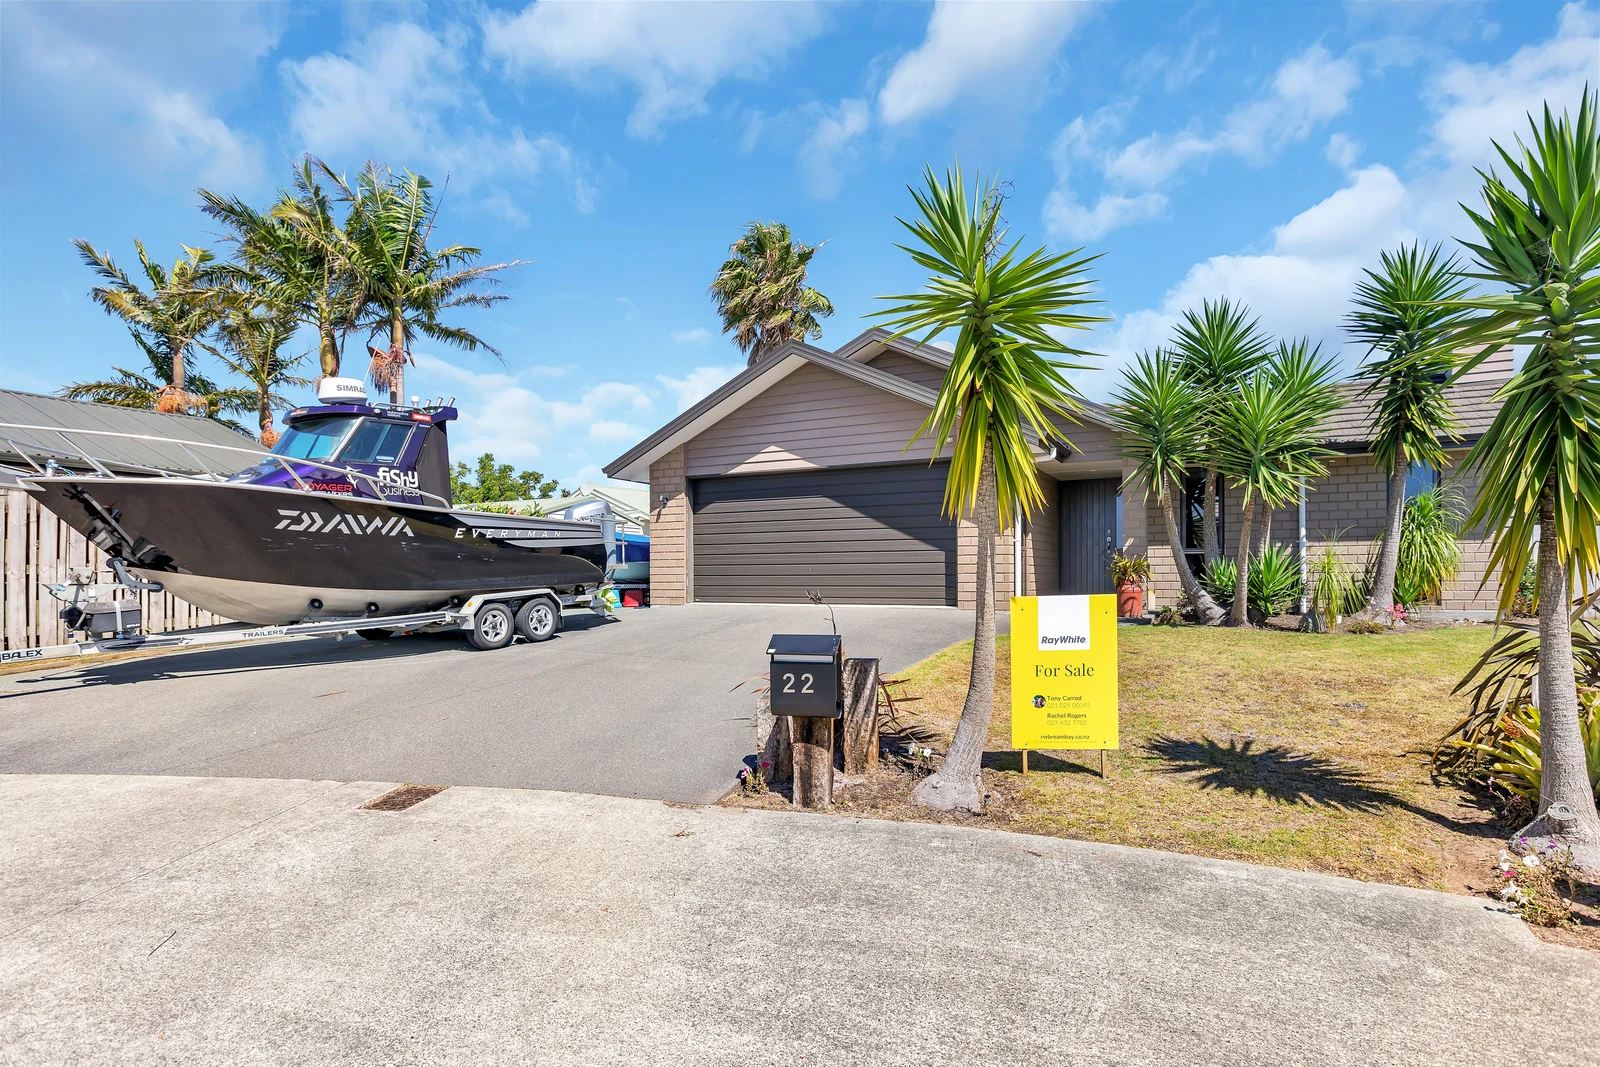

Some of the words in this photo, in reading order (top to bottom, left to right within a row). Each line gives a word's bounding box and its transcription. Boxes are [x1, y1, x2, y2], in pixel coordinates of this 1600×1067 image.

[274, 508, 415, 537] DAIWA
[454, 527, 562, 539] EVERYMAN
[242, 629, 284, 638] TRAILERS
[1, 649, 43, 661] BALEX
[1035, 664, 1060, 677] For
[1065, 663, 1095, 677] Sale
[782, 672, 815, 694] 22
